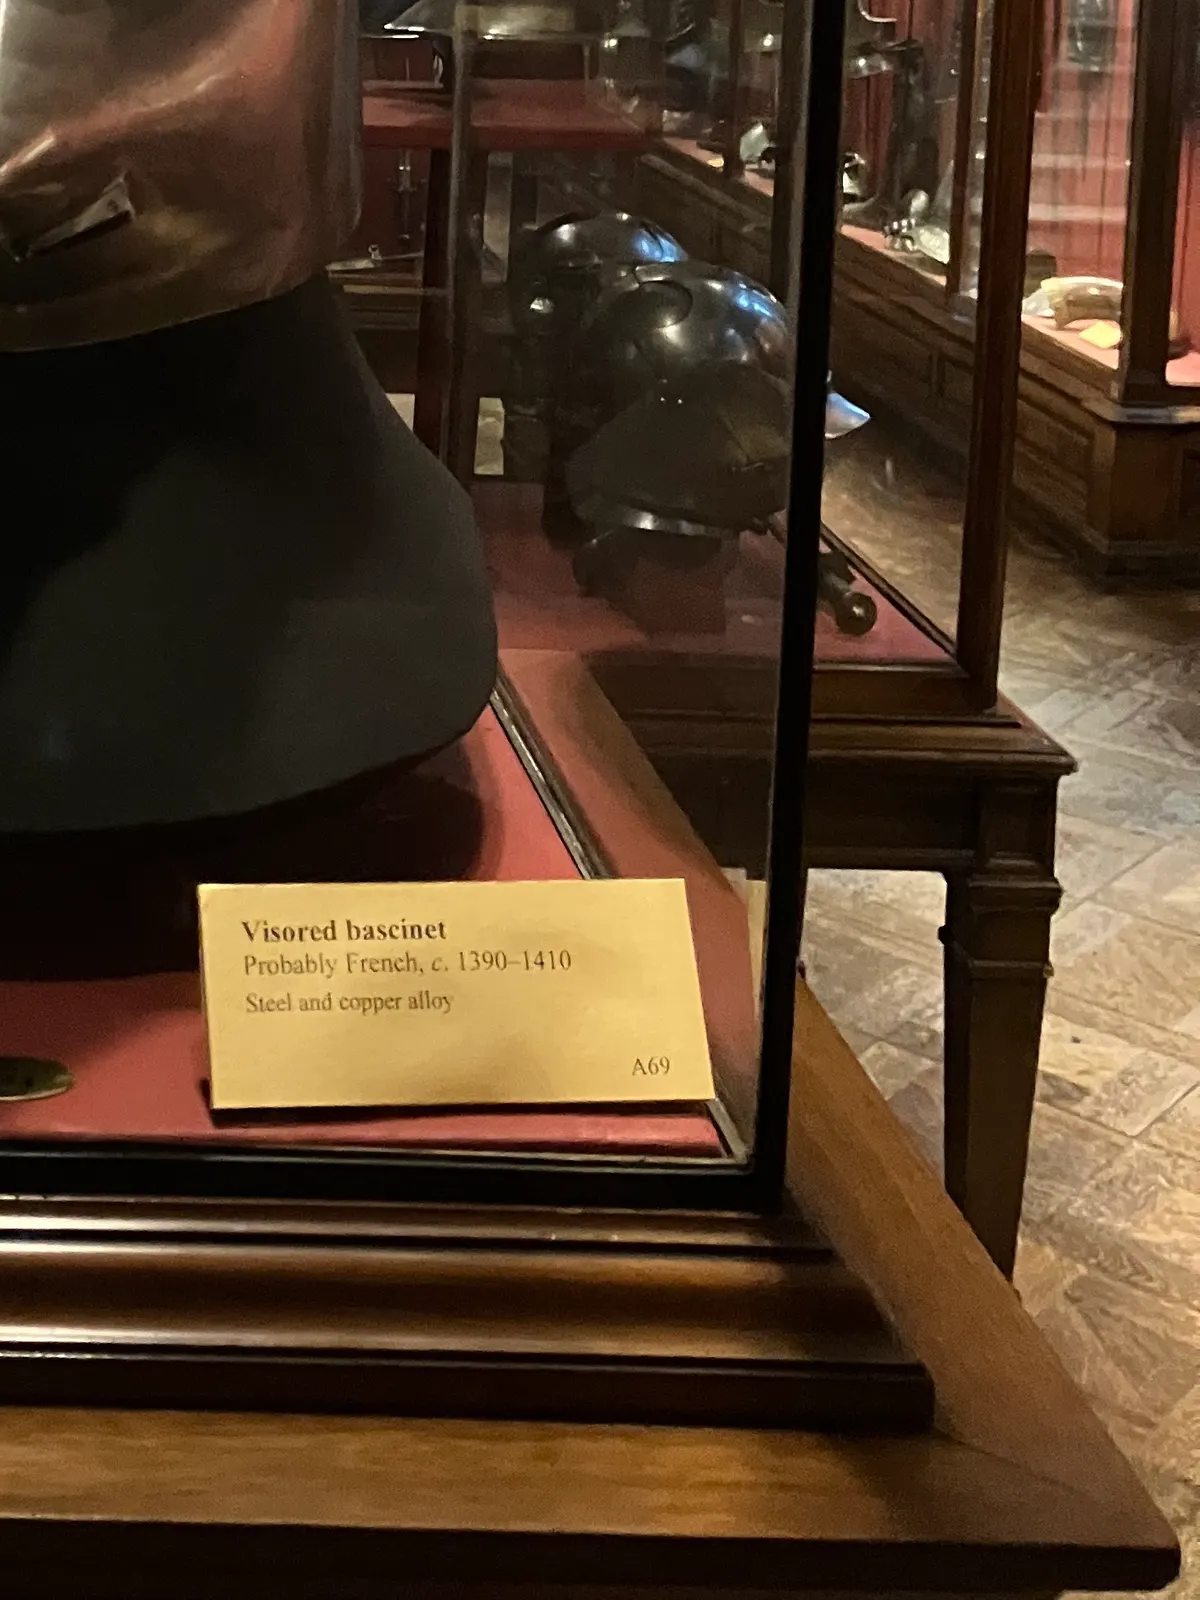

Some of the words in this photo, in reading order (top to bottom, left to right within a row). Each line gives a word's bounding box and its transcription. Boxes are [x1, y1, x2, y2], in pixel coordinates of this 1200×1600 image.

[241, 920, 337, 943] Visored
[346, 918, 447, 941] bascinet
[244, 953, 337, 979] Probably
[346, 952, 424, 975] French,
[431, 957, 449, 972] c.
[246, 992, 292, 1014] Steel
[299, 992, 332, 1011] and
[339, 996, 402, 1016] copper
[408, 990, 453, 1014] alloy
[632, 1056, 671, 1076] A69
